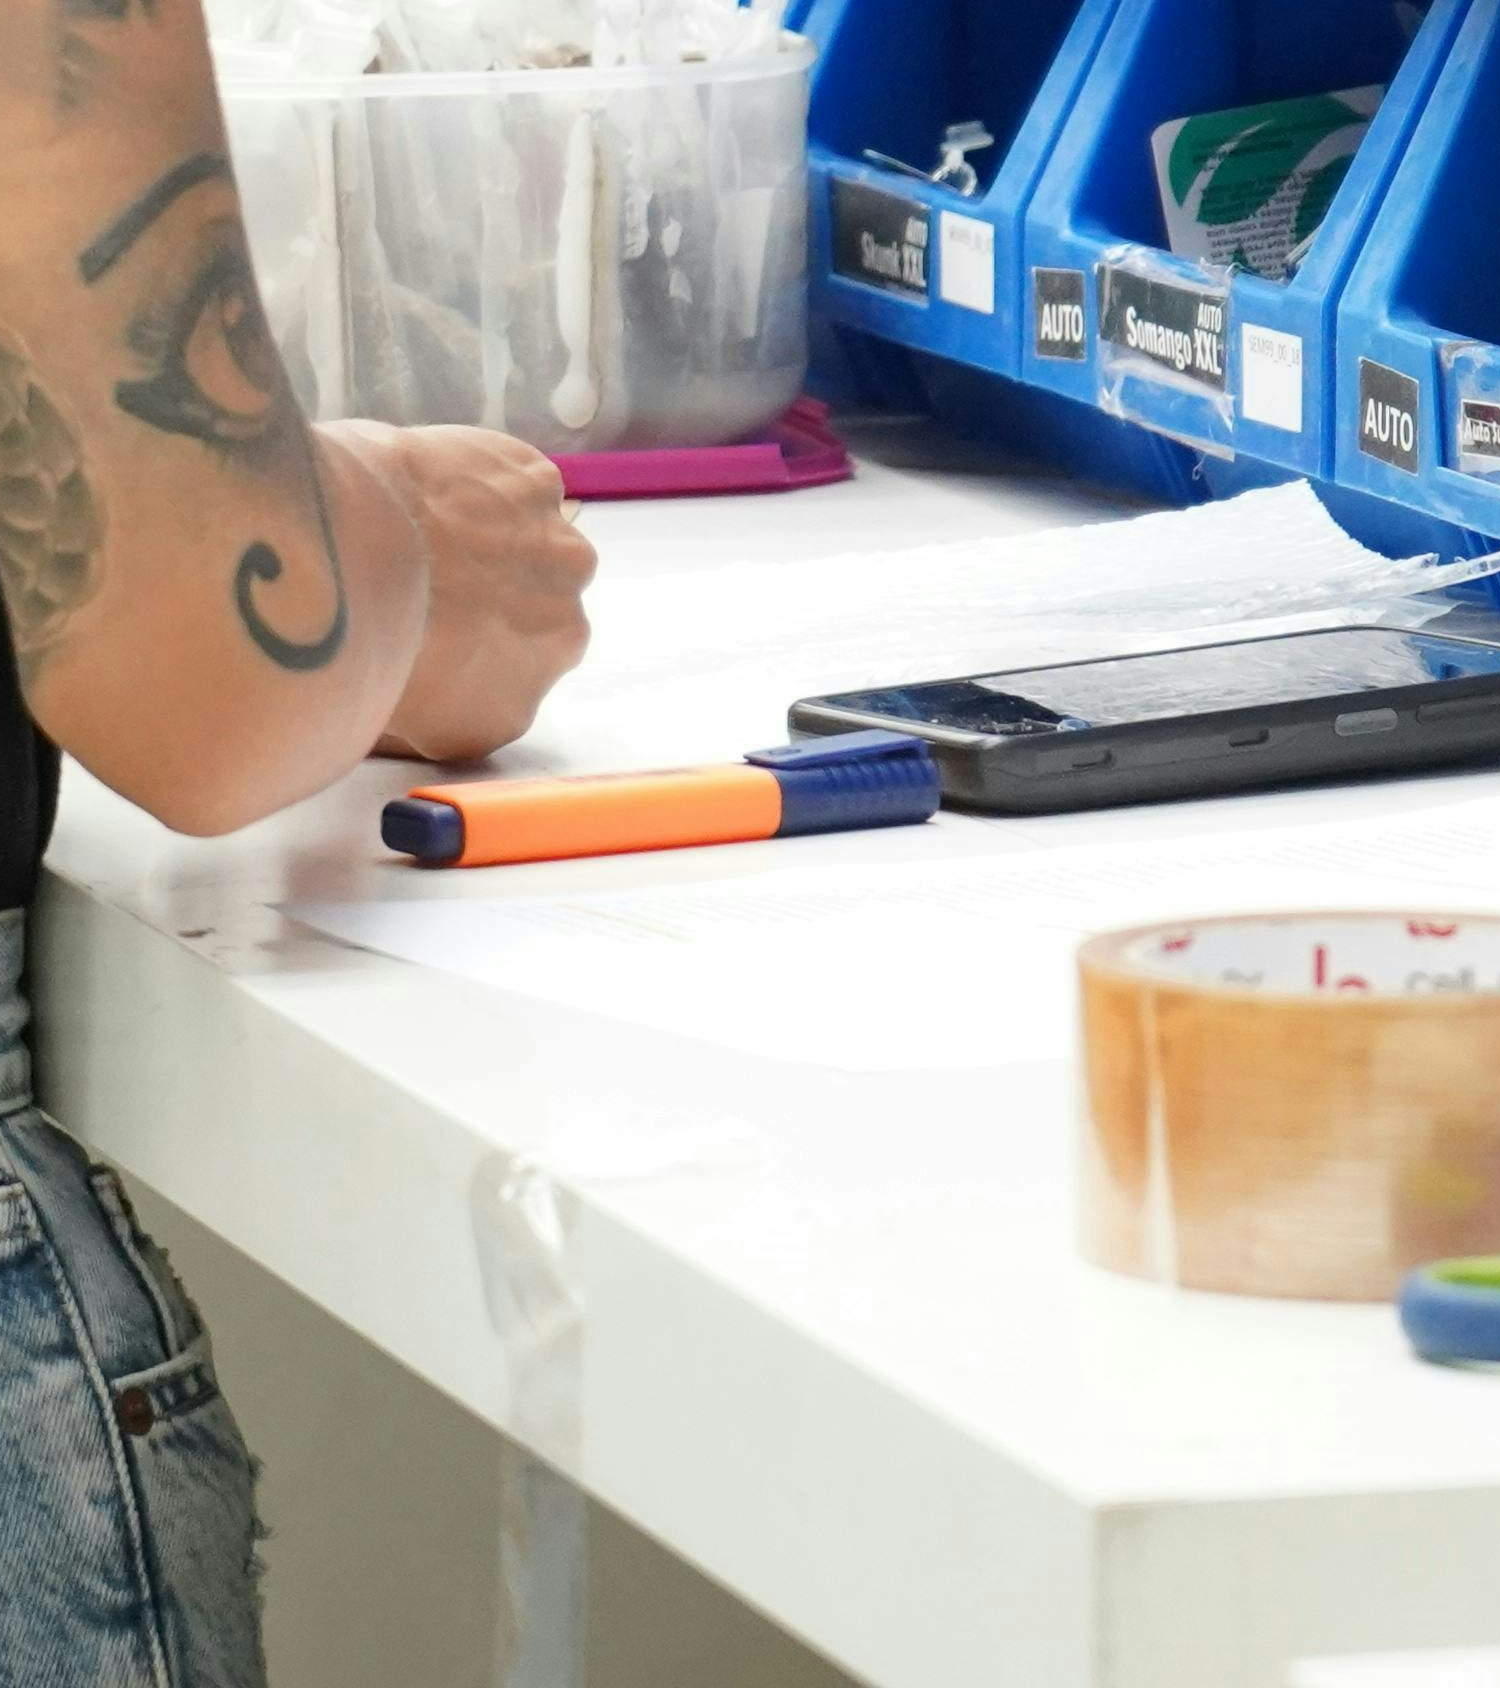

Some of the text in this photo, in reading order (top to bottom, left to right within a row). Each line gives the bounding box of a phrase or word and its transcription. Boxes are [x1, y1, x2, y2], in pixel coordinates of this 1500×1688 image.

[1040, 303, 1082, 342] AUTO
[1196, 301, 1222, 331] AUTO
[1126, 305, 1223, 375] Somango XXL
[1364, 398, 1413, 453] AUTO
[1463, 417, 1490, 443] Auto
